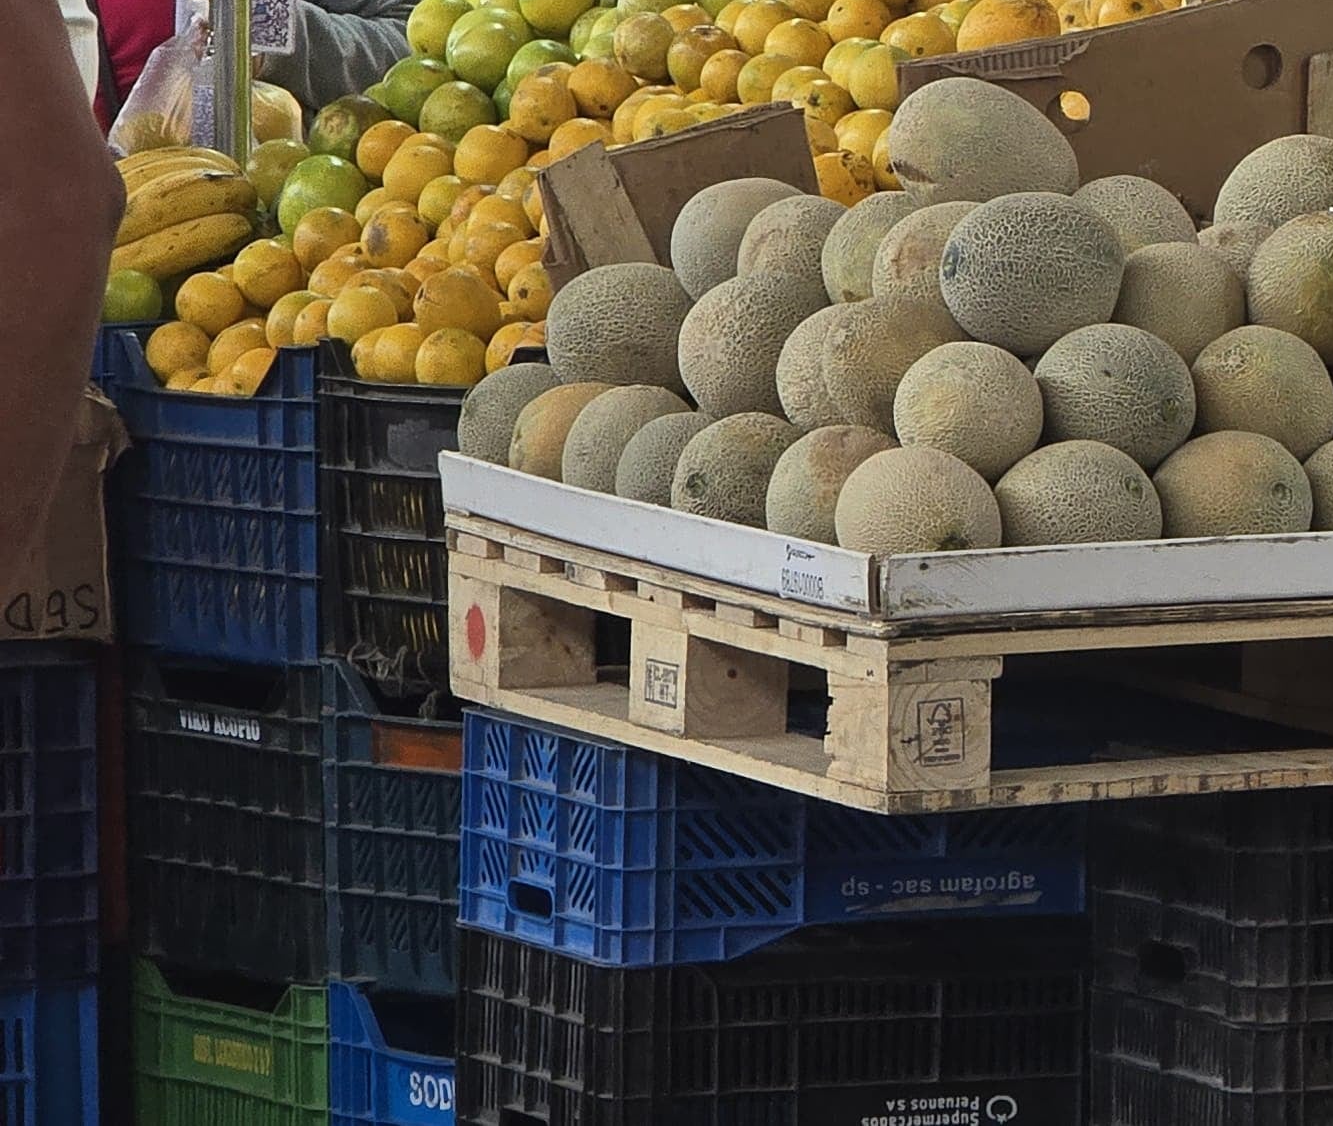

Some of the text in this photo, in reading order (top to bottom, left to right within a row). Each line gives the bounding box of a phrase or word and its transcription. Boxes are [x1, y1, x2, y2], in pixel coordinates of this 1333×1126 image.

[891, 878, 932, 894] sac
[939, 871, 1036, 896] agrofam
[910, 1095, 980, 1111] Peruanos
